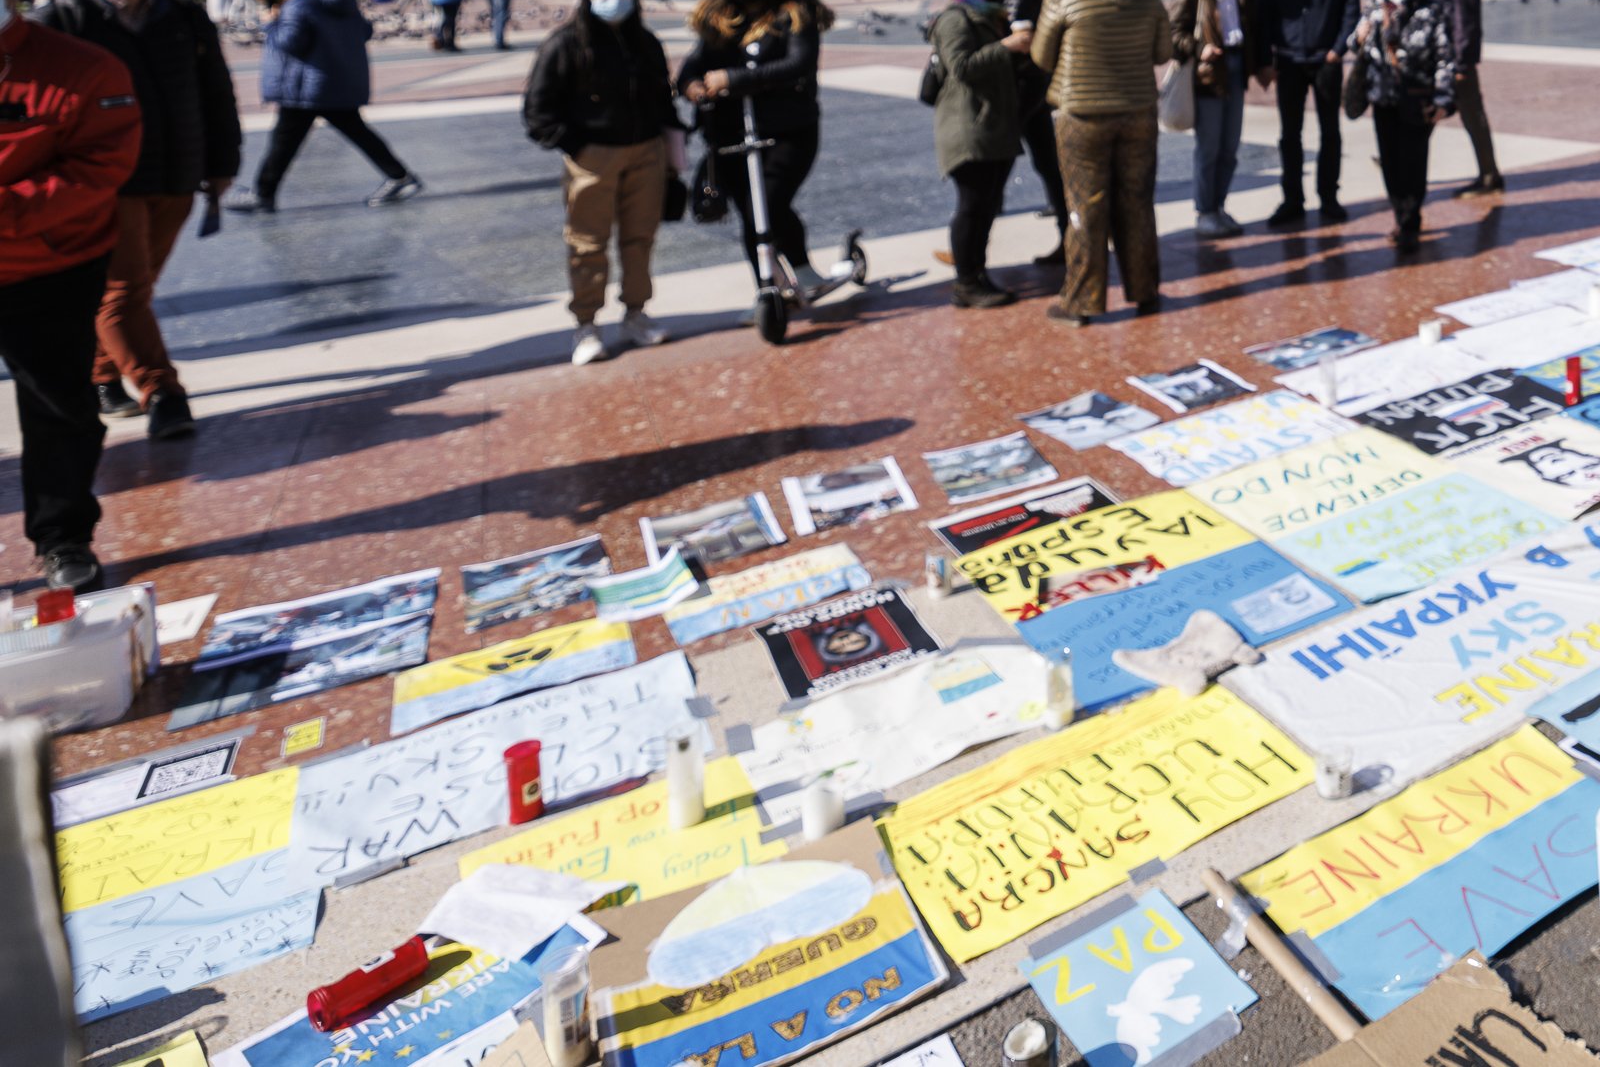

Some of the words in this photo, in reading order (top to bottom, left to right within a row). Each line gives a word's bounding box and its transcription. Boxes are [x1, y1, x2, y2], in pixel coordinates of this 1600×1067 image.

[1212, 447, 1380, 504] MUNDO
[1263, 470, 1423, 533] DEFIENDE
[1005, 555, 1166, 622] KILLER
[1523, 544, 1570, 569] В
[1290, 572, 1517, 681] УКРАЇНІ
[1449, 601, 1567, 671] SKY
[540, 680, 656, 731] THE
[943, 738, 1224, 893] UCRANIA
[1171, 741, 1299, 825] HOY
[309, 808, 461, 875] WAR
[502, 819, 601, 867] Putin
[661, 837, 749, 881] Today
[1279, 749, 1563, 920] UKRAINE
[112, 847, 289, 929] SAVE
[951, 813, 1151, 932] SANGRA
[453, 958, 510, 999] ARE
[658, 915, 878, 1017] GUERRA
[1030, 908, 1184, 1006] PAZ
[366, 997, 453, 1047] WITH
[825, 964, 902, 1020] NO
[681, 1031, 758, 1067] LA
[769, 1010, 809, 1043] A
